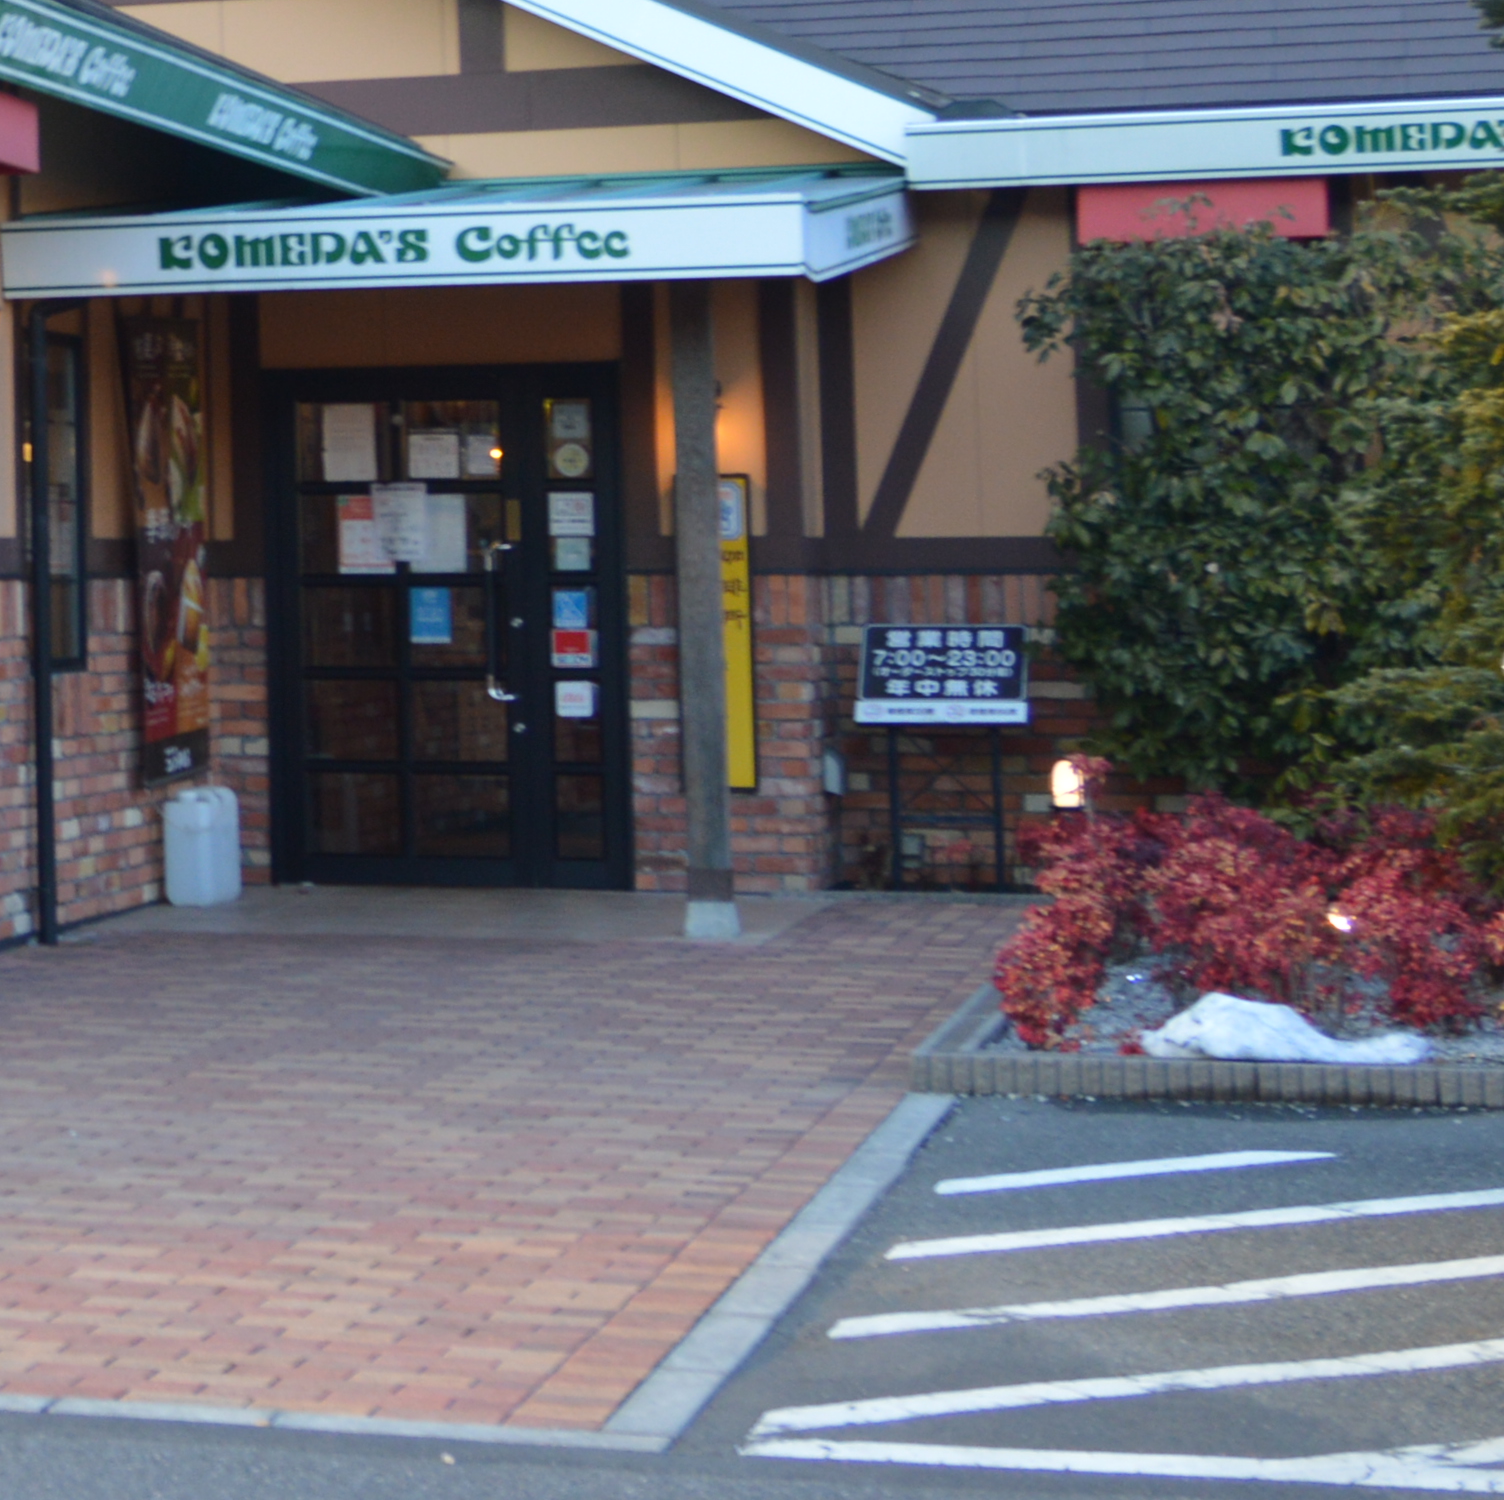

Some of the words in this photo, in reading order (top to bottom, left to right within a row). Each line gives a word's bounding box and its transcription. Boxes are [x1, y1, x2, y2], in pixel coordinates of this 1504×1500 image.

[158, 228, 429, 270] KOMEDA'S
[455, 223, 631, 262] Coffee
[885, 629, 1005, 649] 営業時間
[884, 678, 1000, 697] 年中無休
